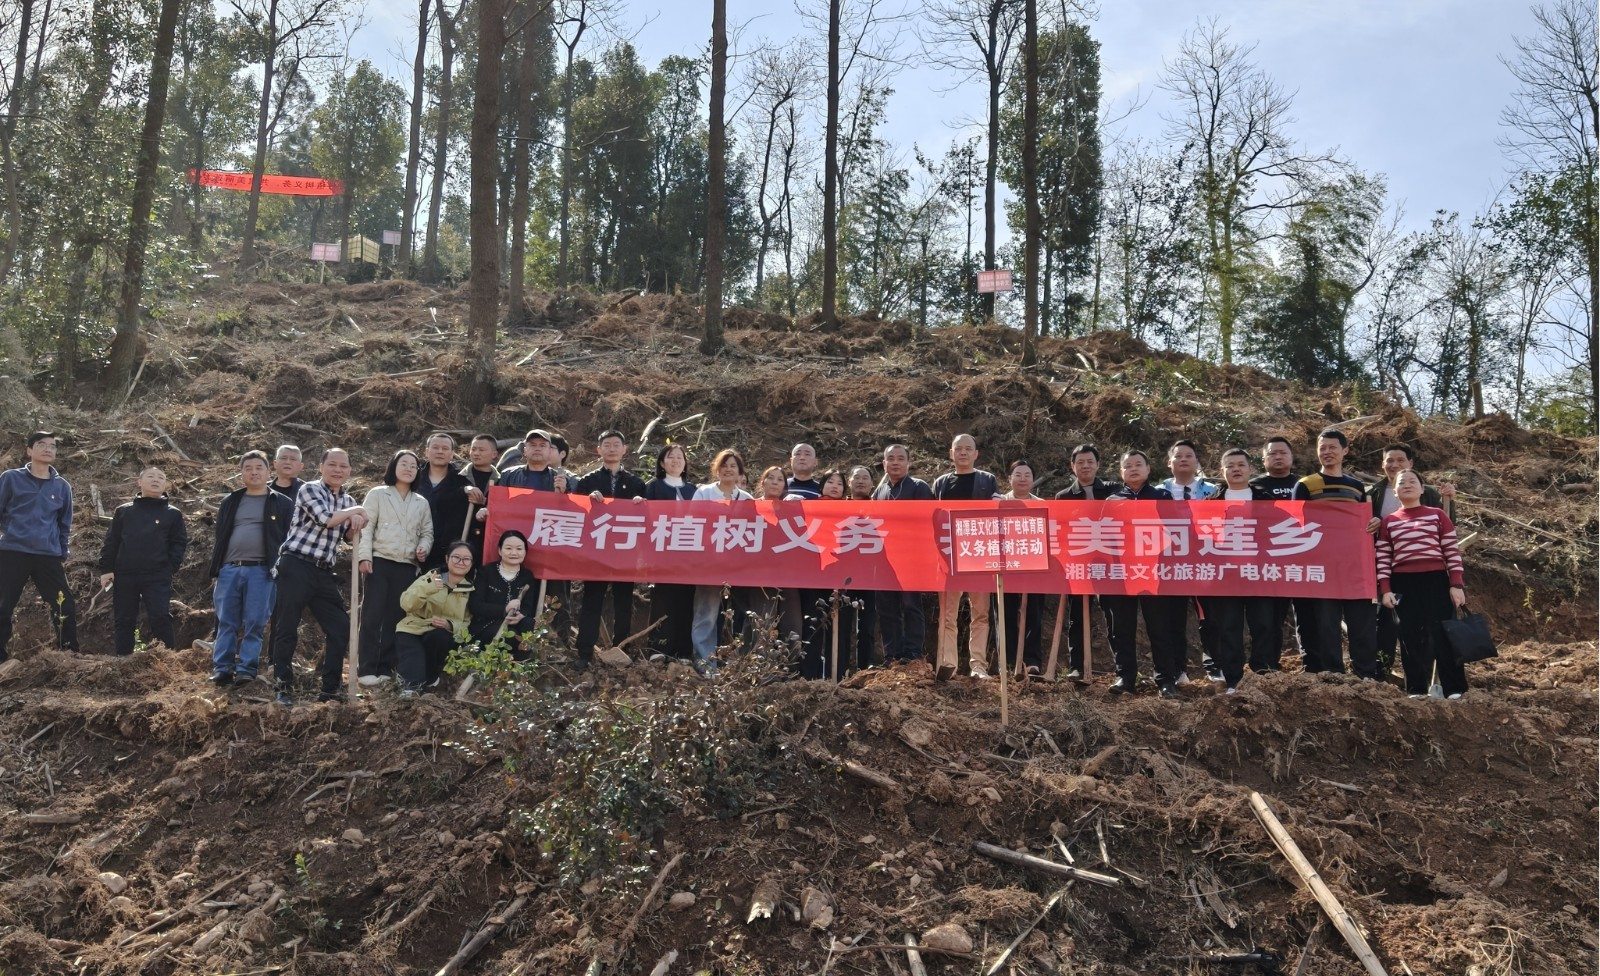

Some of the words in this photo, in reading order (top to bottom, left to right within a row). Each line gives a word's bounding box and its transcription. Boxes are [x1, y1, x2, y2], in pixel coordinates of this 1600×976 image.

[528, 508, 889, 555] 履行植树义务
[940, 517, 1324, 558] 美丽莲乡
[955, 517, 1045, 537] 湘潭县文化旅游广电体育局
[959, 538, 1043, 557] 义务植树活动
[1065, 563, 1326, 583] 湘潭县文化旅游广电体育局
